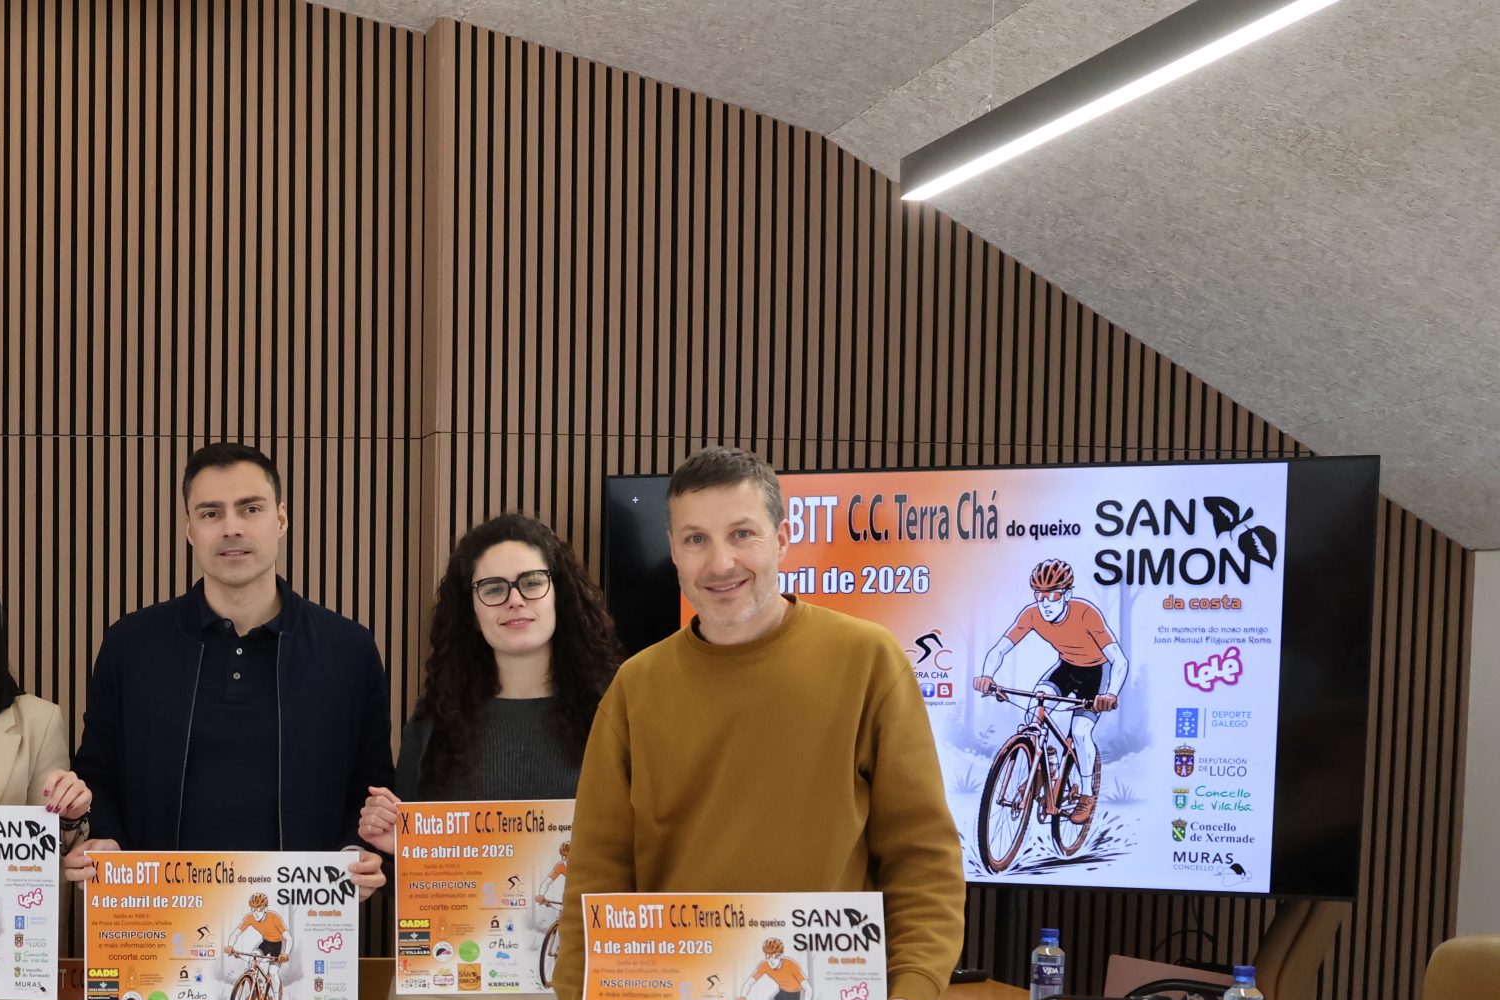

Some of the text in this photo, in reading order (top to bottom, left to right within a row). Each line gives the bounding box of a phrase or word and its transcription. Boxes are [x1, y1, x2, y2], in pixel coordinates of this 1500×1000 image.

[788, 491, 1081, 544] BTT C.C. Terra Chá do queixo
[1094, 499, 1196, 538] SAN
[1094, 547, 1251, 587] SIMON
[822, 567, 854, 595] de
[861, 565, 930, 595] 2026
[1162, 595, 1242, 610] da costa
[1244, 626, 1268, 635] amigo
[1153, 636, 1171, 644] Juan
[1212, 710, 1252, 719] DEPORTE
[1212, 719, 1248, 728] GALEGO
[1198, 756, 1248, 765] DEPUTACIÓN
[1209, 766, 1247, 777] LUGO
[1195, 785, 1251, 798] Concello
[1190, 800, 1253, 811] de Vilalba
[401, 812, 409, 834] X
[415, 811, 442, 834] Ruta
[446, 811, 469, 834] BTT
[474, 811, 493, 832] C.C.
[496, 811, 522, 832] Terra
[525, 809, 544, 832] Chá
[1190, 821, 1237, 832] Concello
[1190, 833, 1255, 844] de Xermade
[402, 844, 514, 858] 4 de abril de 2026
[1173, 851, 1234, 864] MURAS
[91, 861, 99, 883] X
[105, 861, 132, 884] Ruta
[136, 862, 159, 884] BTT
[164, 861, 183, 882] C.C.
[185, 862, 211, 883] Terra
[215, 861, 233, 883] Chá
[248, 875, 271, 883] queixo
[277, 866, 320, 882] SAN
[91, 895, 203, 907] 4 de abril de 2026
[277, 888, 344, 905] SIMON
[591, 903, 785, 928] X Ruta BTT C.C. Terra Chá do queixo
[792, 908, 840, 926] SAN
[399, 919, 429, 927] GADIS
[593, 940, 713, 953] 4 de abril de 2026
[793, 933, 868, 951] SIMON
